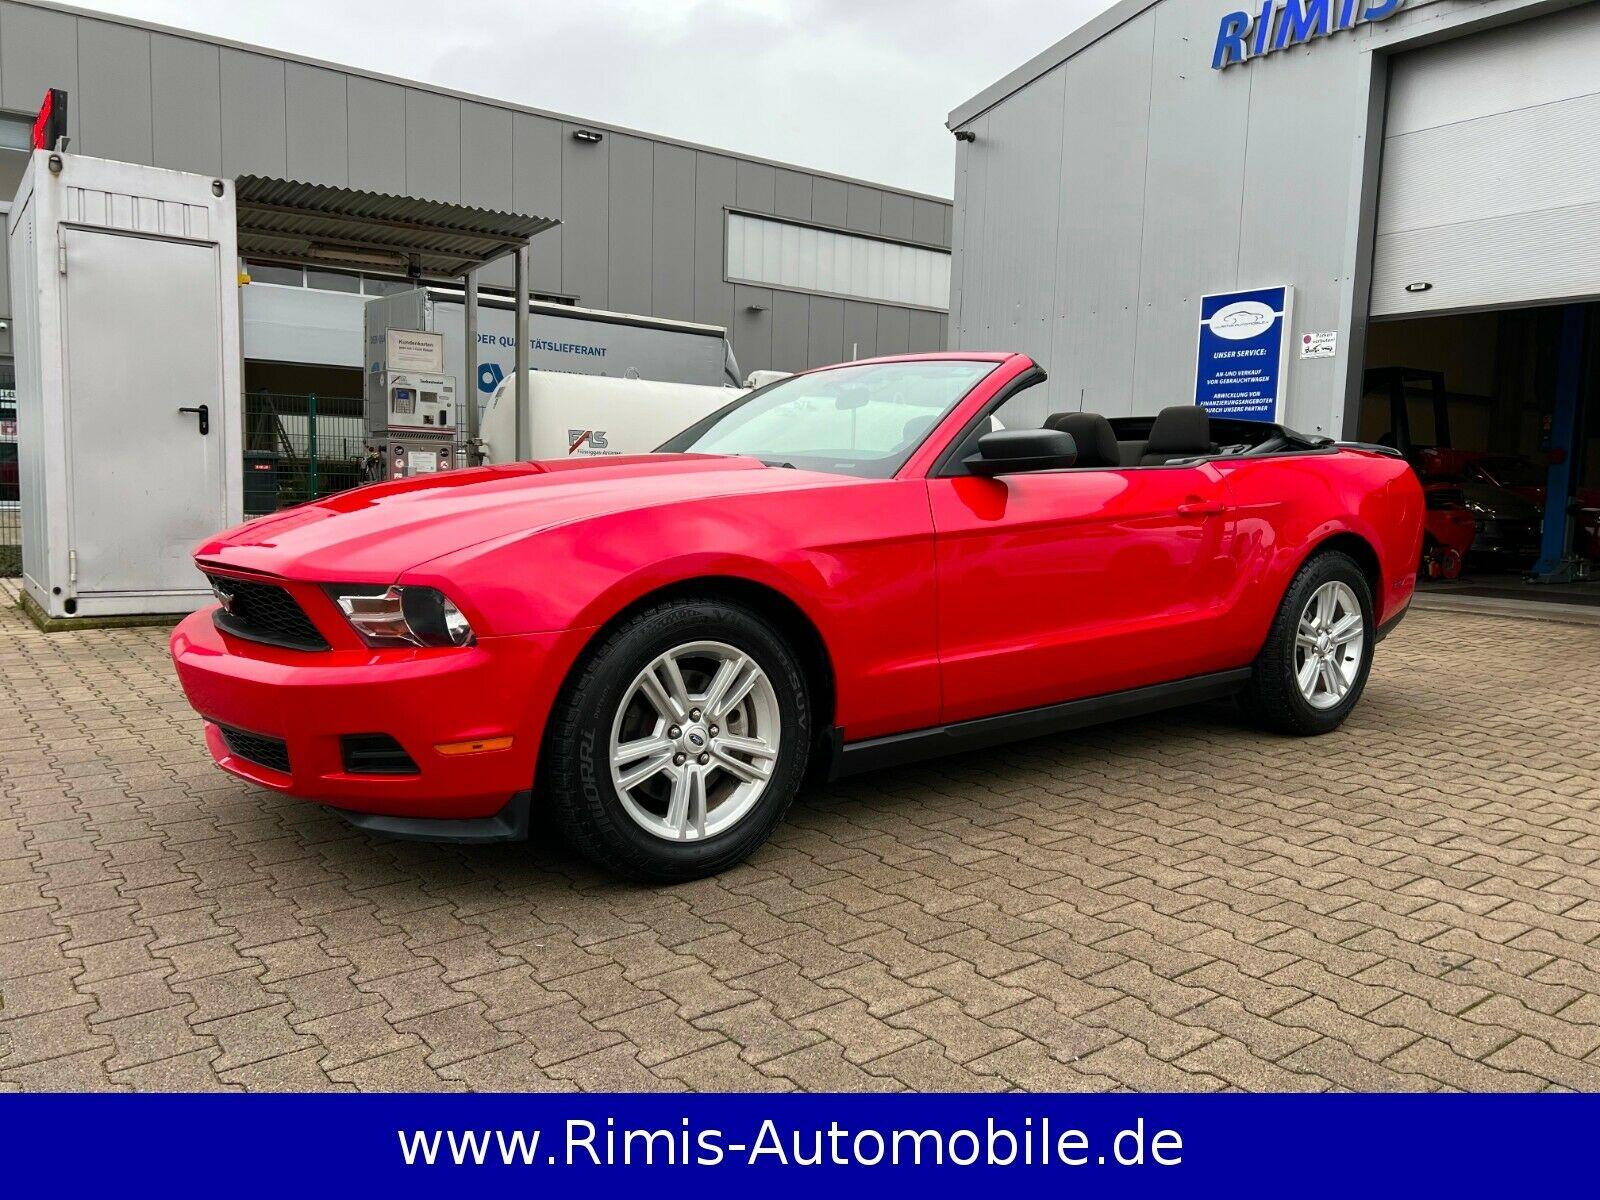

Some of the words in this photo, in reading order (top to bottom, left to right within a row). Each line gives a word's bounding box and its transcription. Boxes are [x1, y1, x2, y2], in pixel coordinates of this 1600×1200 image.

[499, 335, 607, 357] QUTÄTSLIEFERANT
[1213, 351, 1236, 359] UNSER
[1236, 348, 1267, 357] SERVICE:
[1219, 376, 1270, 384] GEBRAUCHTWAGEN
[1200, 398, 1273, 406] FINANZIERUNGSANGEBOTEN
[568, 429, 609, 455] FAS
